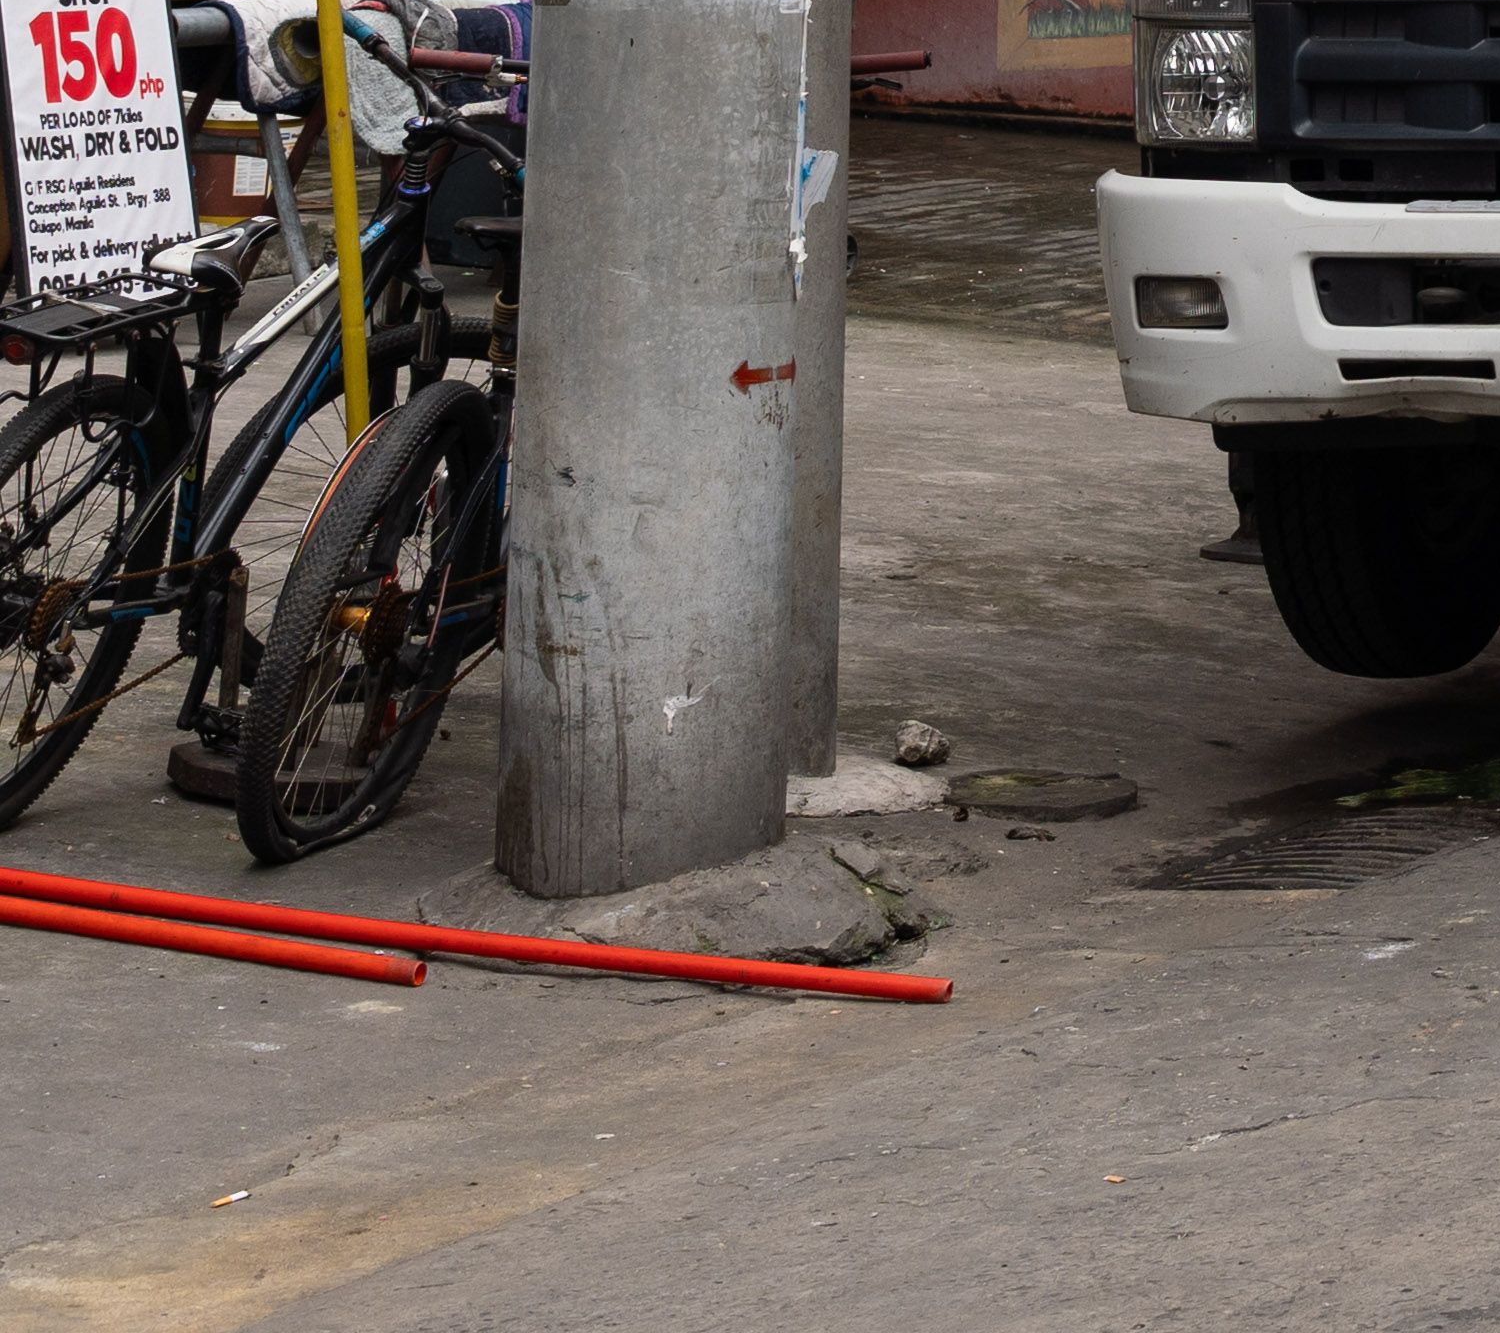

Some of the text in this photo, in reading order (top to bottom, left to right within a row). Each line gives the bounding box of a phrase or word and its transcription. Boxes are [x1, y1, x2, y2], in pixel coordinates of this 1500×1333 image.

[29, 7, 138, 104] 150
[139, 72, 165, 101] php
[40, 107, 143, 130] PER LOAD OF 7kilos
[20, 126, 179, 161] WASH, DRY & FOLD
[153, 188, 171, 203] 388
[30, 239, 138, 267] For pick & delivery
